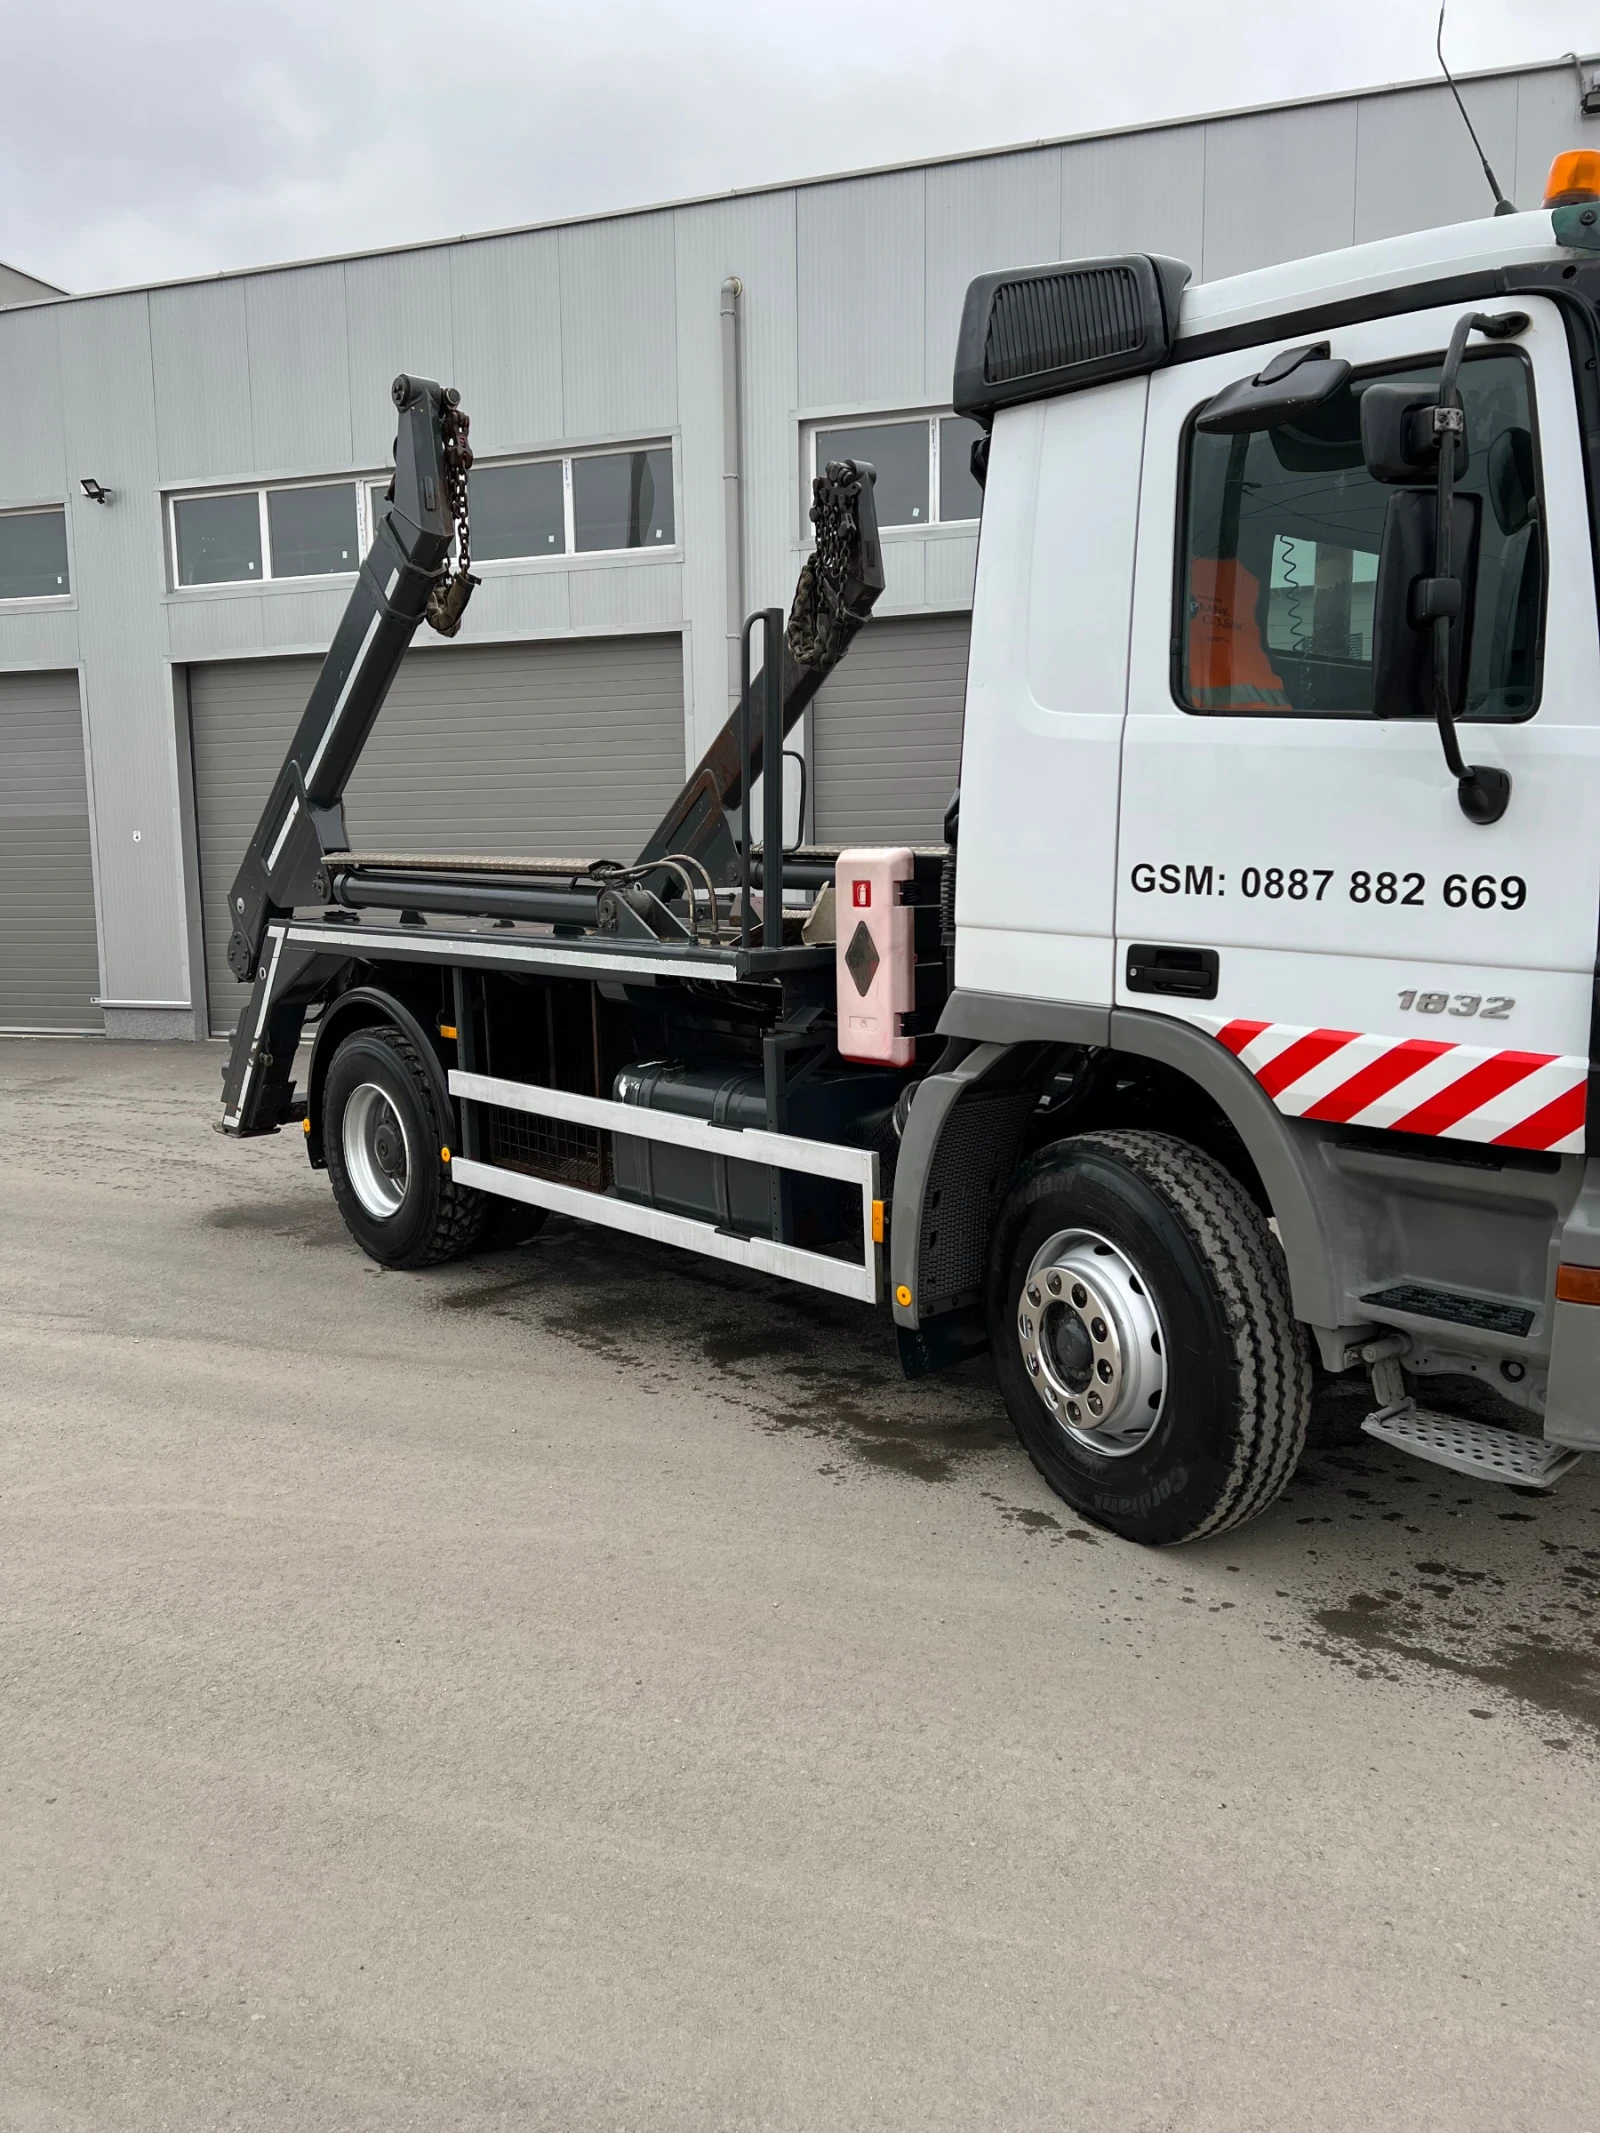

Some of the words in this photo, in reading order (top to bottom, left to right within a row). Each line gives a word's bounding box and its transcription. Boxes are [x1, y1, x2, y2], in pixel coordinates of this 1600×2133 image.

[1131, 863, 1226, 897] GSM:
[1241, 867, 1335, 902] 0887
[1349, 870, 1426, 907] 882
[1442, 873, 1528, 911] 669
[1397, 988, 1517, 1021] 1832
